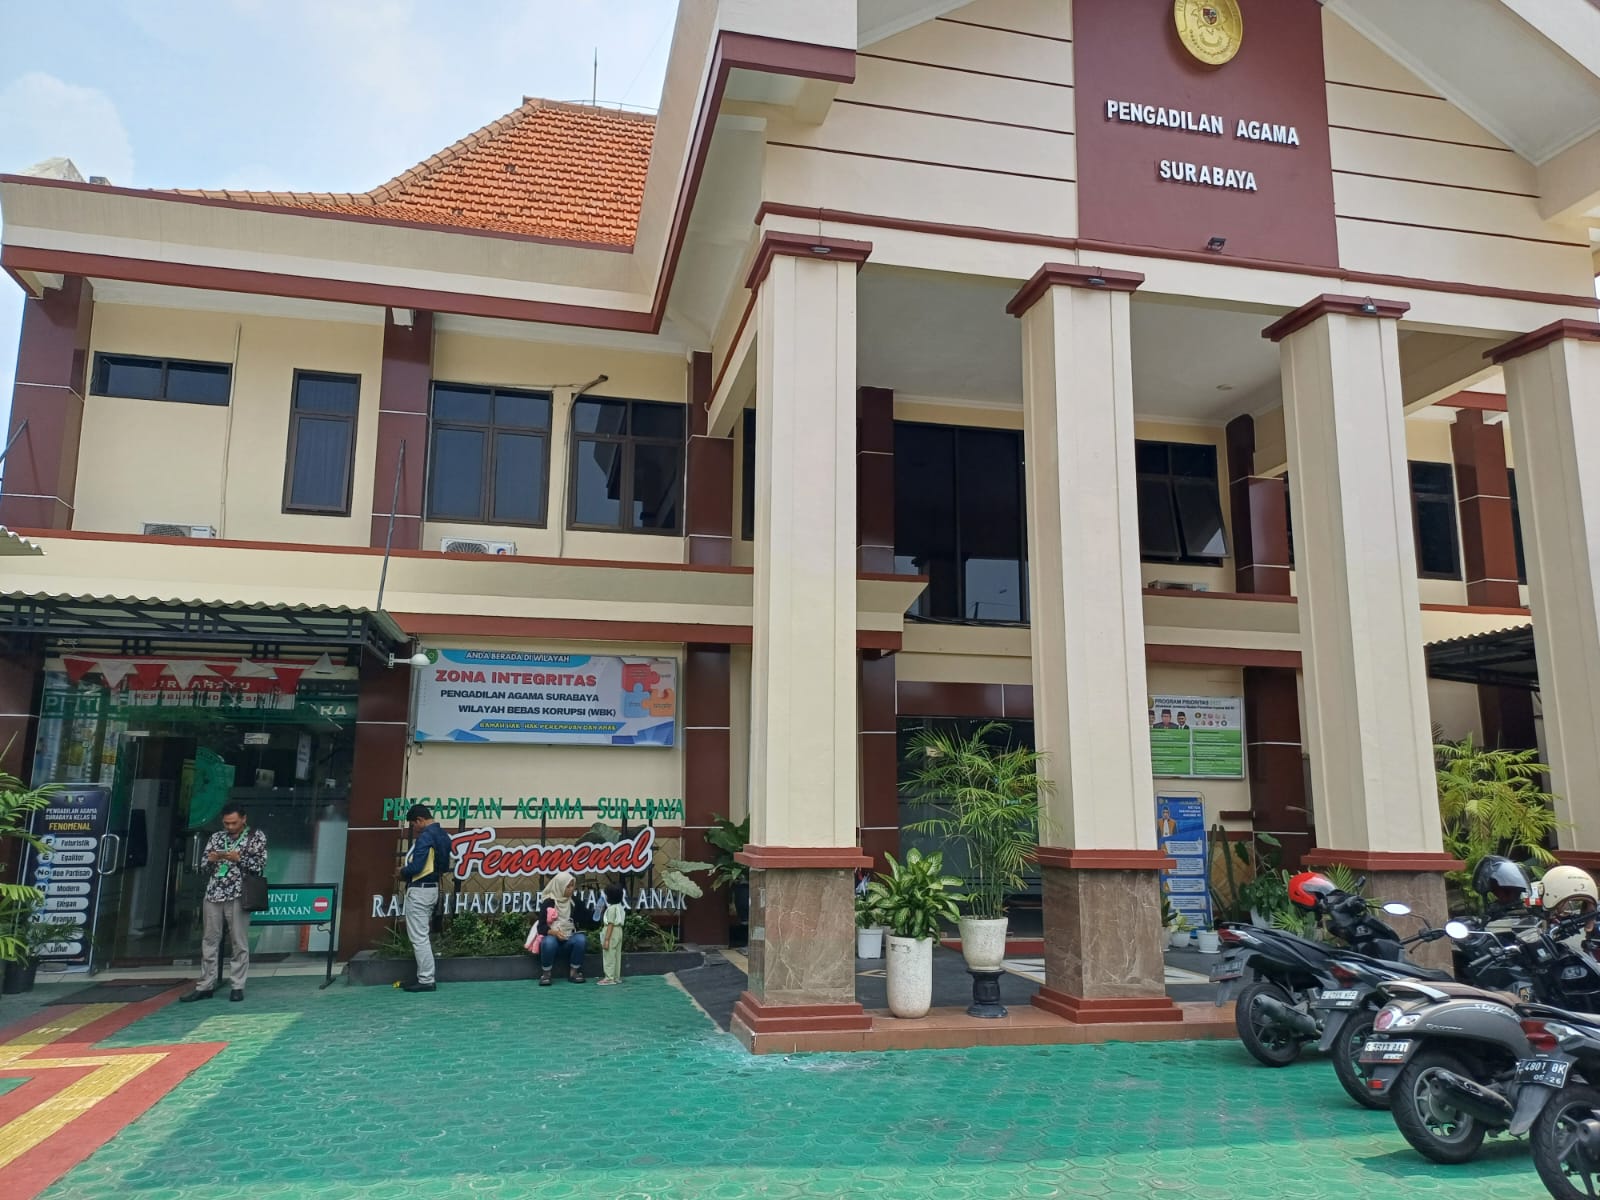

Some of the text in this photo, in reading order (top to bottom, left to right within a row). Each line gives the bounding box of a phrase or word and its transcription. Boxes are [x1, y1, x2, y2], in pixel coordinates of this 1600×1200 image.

[1106, 99, 1300, 146] PENGADILAN AGAMA
[1159, 159, 1257, 191] SURABAYA
[465, 651, 570, 663] ANDA BERADA DI WILAYAH
[435, 669, 597, 687] ZONA INTEGRITAS
[440, 689, 600, 702] PENGADILAN AGAMA SURABAYA
[458, 704, 616, 718] WILAYAH BEBAS KORUPSI (WBK)
[514, 797, 583, 820] AGAMA
[597, 797, 685, 820] SURABAYA
[49, 822, 92, 831] FENOMENAL
[61, 838, 90, 847] Futuristik
[451, 829, 652, 877] Fenomenal
[268, 893, 298, 902] INTU
[455, 892, 496, 914] HAK
[637, 888, 687, 910] ANAK
